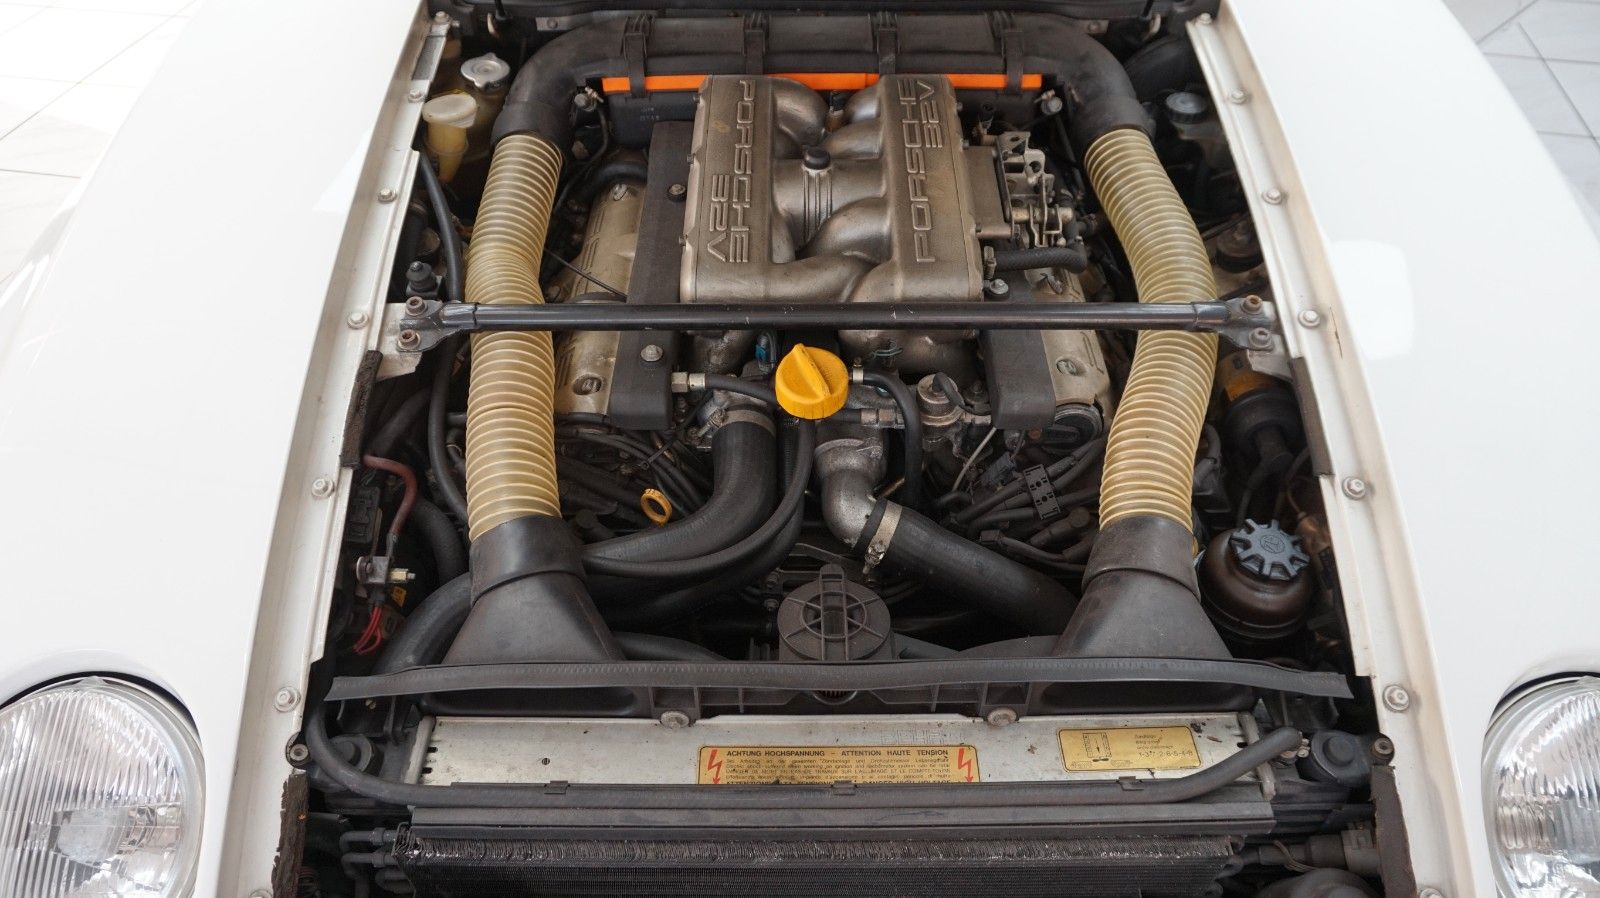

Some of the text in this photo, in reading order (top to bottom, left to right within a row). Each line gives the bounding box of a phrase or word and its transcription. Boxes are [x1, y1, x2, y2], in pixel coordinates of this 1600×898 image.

[917, 81, 944, 148] 32V
[729, 80, 755, 263] PORSCHE
[897, 78, 936, 263] PORSCHE
[707, 174, 730, 263] 32V
[841, 749, 882, 757] ATTENTION
